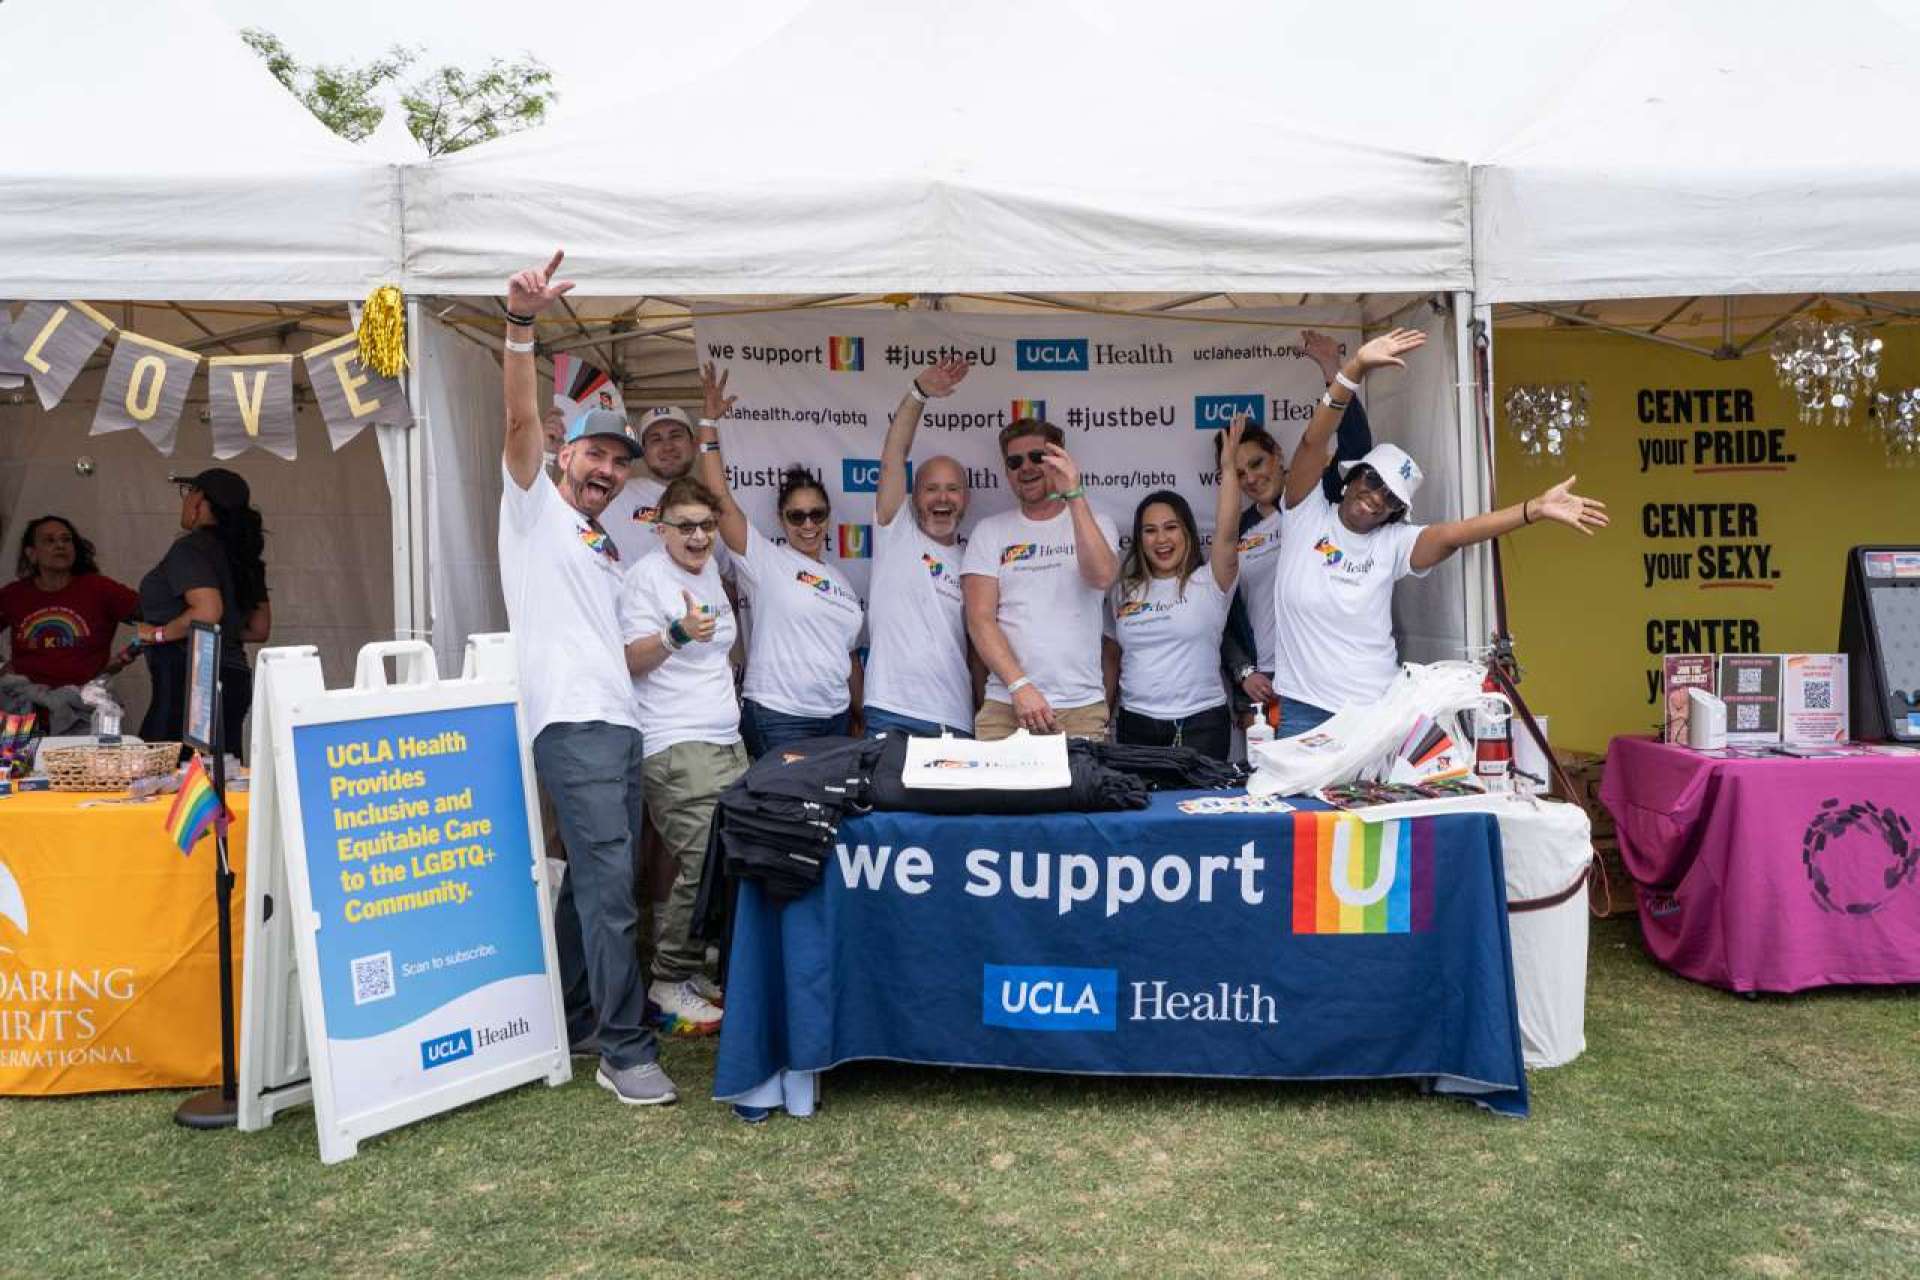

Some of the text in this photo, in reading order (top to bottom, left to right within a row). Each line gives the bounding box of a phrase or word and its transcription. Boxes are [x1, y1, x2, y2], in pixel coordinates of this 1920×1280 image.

[708, 344, 734, 359] we
[742, 345, 822, 365] support
[1026, 344, 1173, 365] UCLA Health
[924, 410, 1005, 431] support
[1067, 406, 1175, 432] #justbeU
[1637, 390, 1755, 423] CENTER
[1638, 429, 1796, 473] your PRIDE.
[1642, 503, 1757, 537] CENTER
[1644, 544, 1780, 587] your SEXY.
[1647, 619, 1760, 653] CENTER
[327, 731, 467, 768] UCLA Health
[330, 768, 426, 799] Provides
[334, 788, 472, 830] Inclusive and
[338, 818, 492, 861] Equitable Care
[341, 844, 496, 893] to the LGBTQ+
[835, 818, 1400, 918] we support U
[345, 881, 472, 923] Community.
[401, 959, 430, 977] Scan
[432, 956, 443, 969] to
[1001, 981, 1280, 1025] UCLA Health
[429, 1017, 529, 1061] UCLA Health
